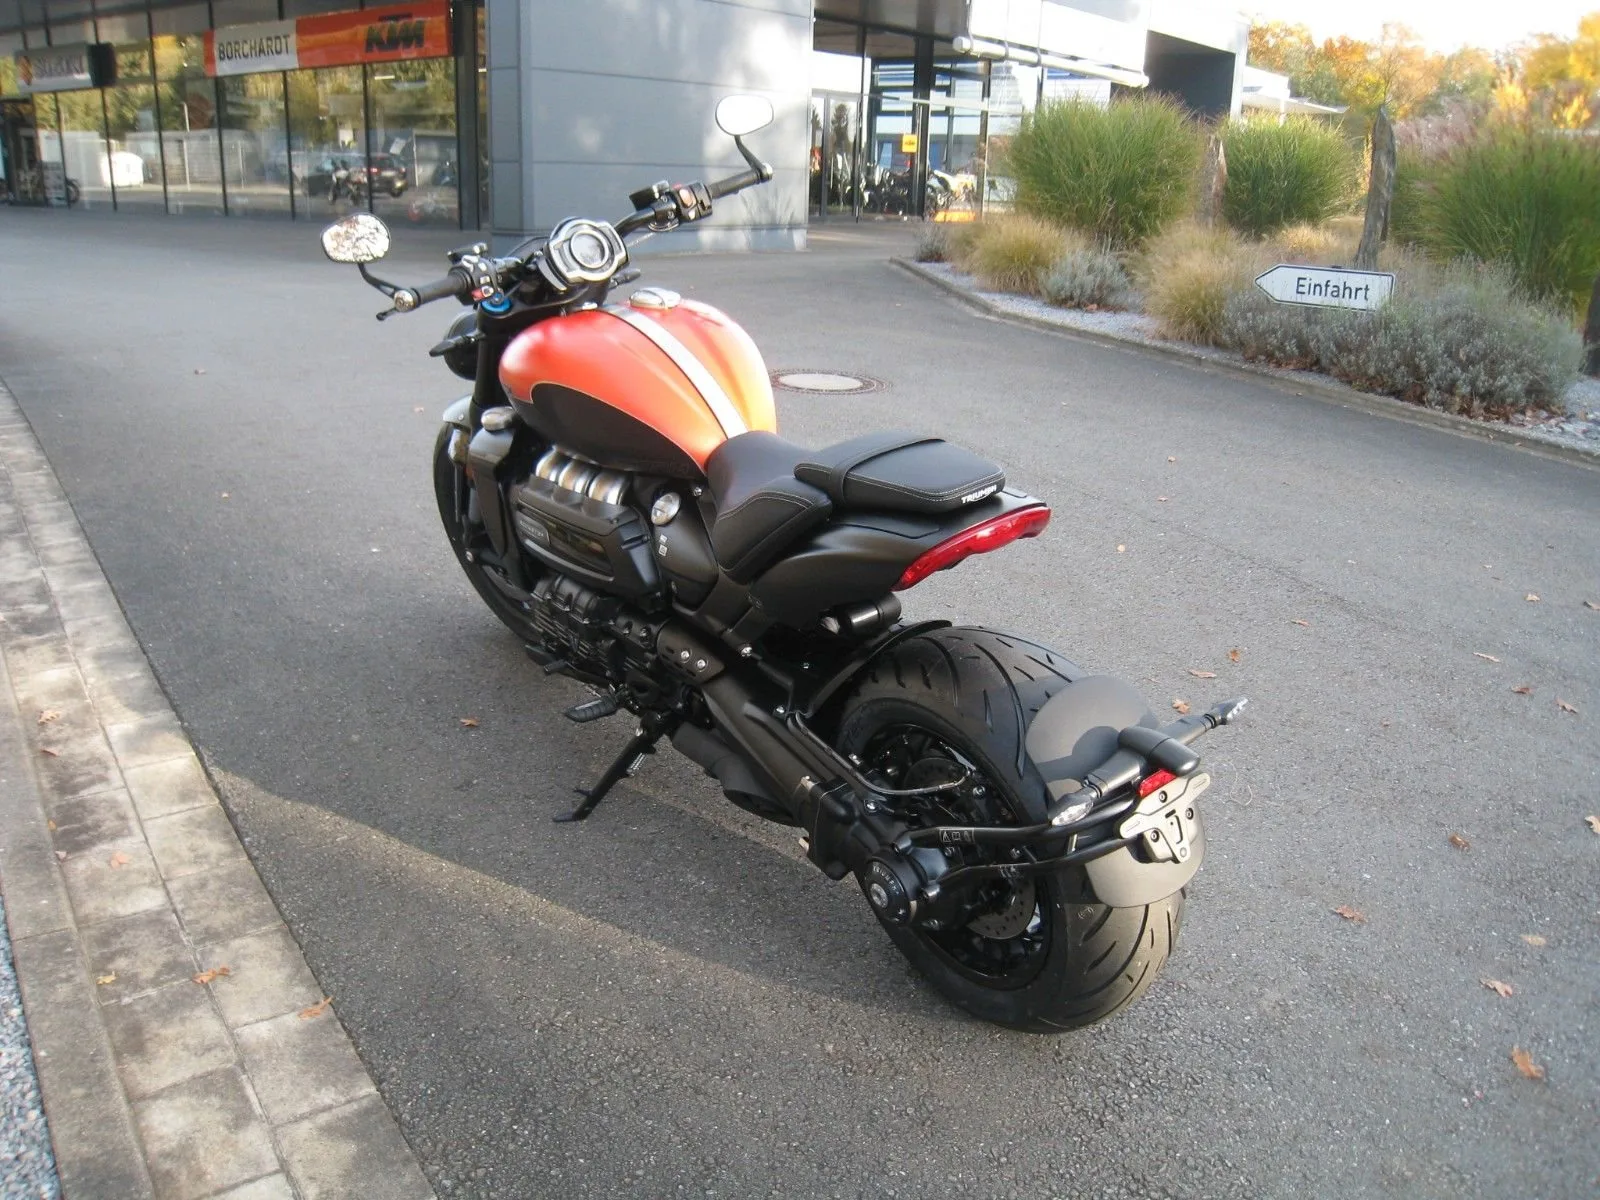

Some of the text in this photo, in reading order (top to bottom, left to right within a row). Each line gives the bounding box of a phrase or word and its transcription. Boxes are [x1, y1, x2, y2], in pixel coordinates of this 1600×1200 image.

[366, 12, 425, 53] KTM
[218, 34, 290, 61] BORCHARDT
[1296, 277, 1370, 301] Einfahrt
[961, 484, 997, 504] TRIUMPH
